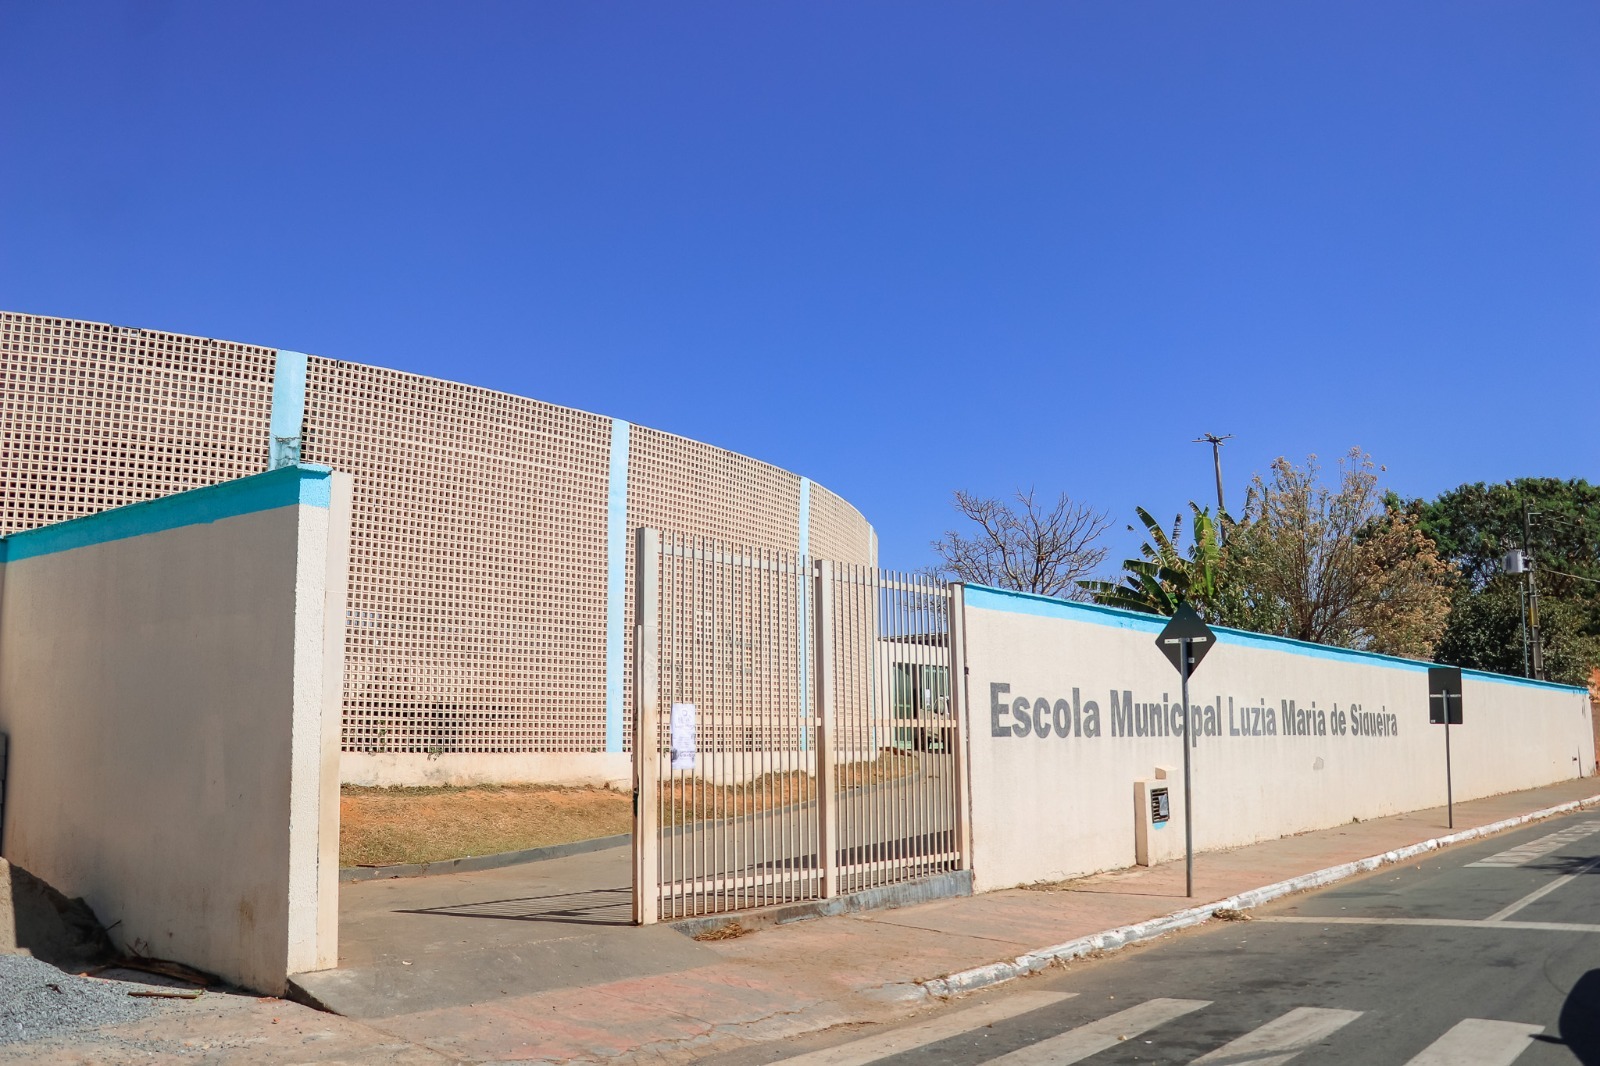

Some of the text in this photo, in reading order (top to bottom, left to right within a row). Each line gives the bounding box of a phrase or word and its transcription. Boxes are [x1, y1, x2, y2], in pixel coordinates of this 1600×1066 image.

[990, 682, 1398, 747] Escola Municpal Luzia Maria de Siqueira
